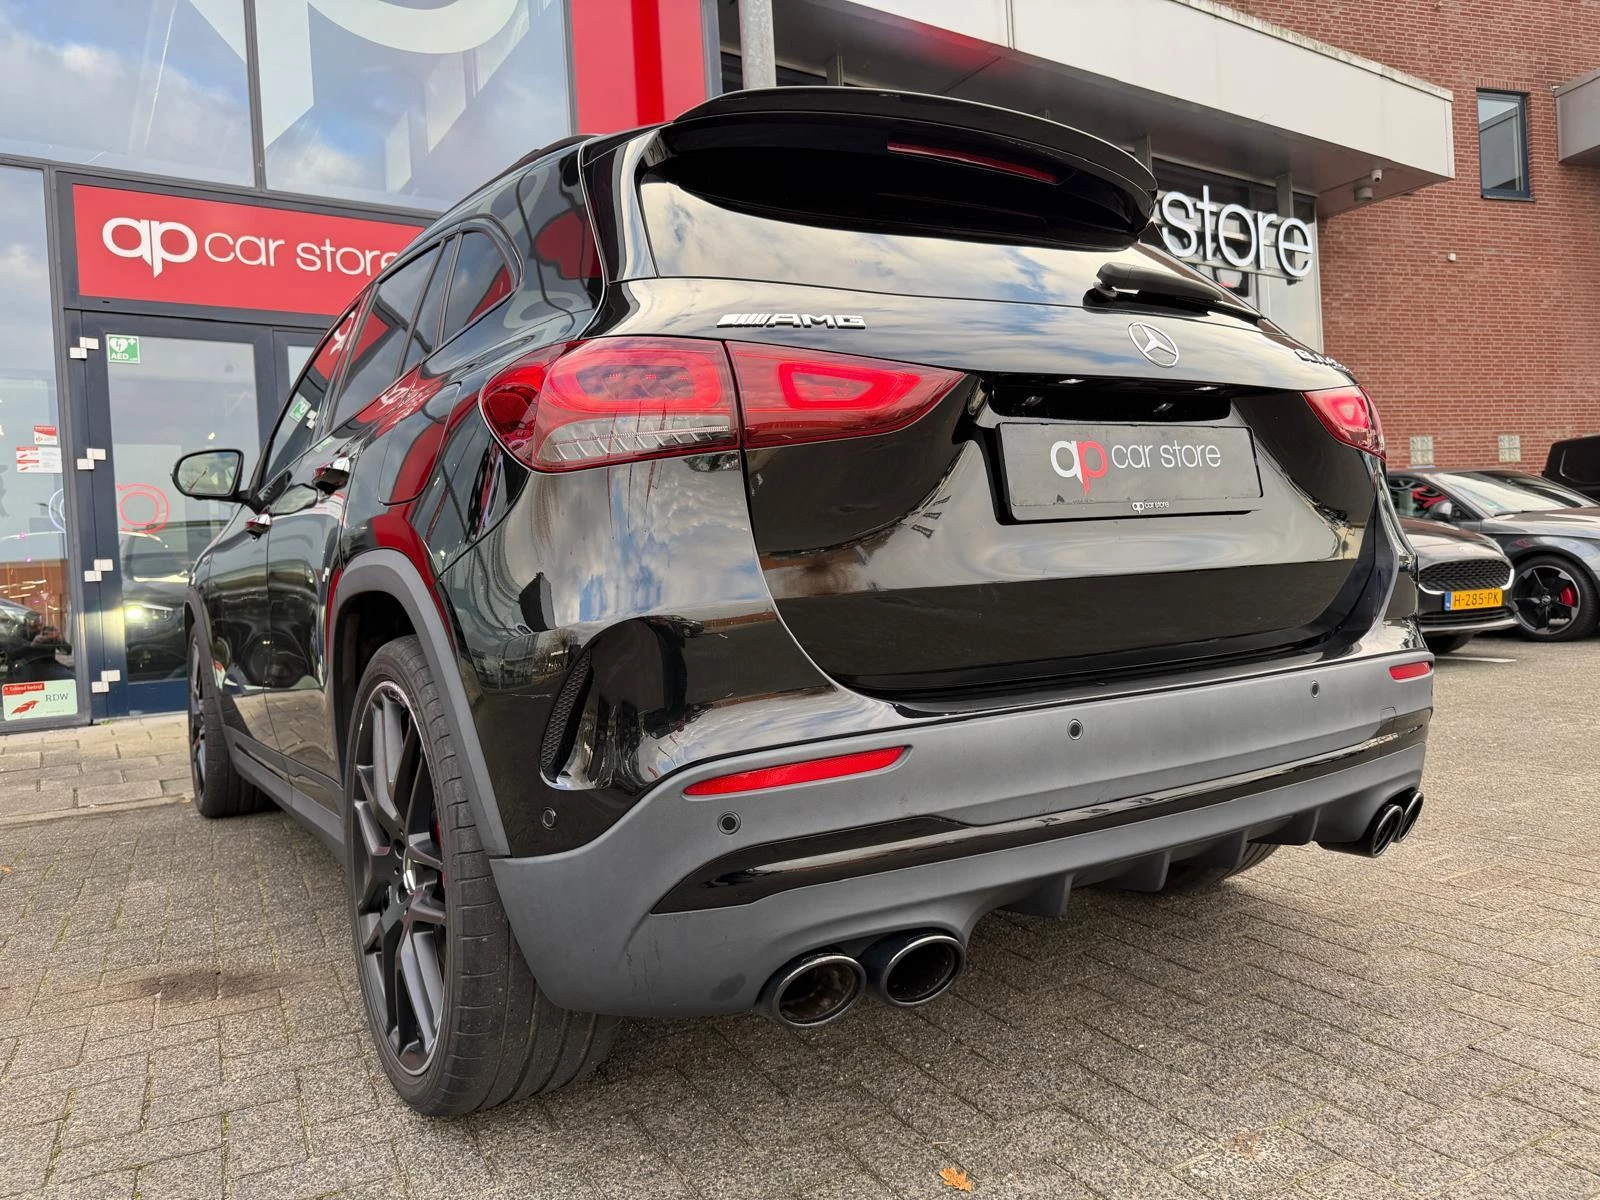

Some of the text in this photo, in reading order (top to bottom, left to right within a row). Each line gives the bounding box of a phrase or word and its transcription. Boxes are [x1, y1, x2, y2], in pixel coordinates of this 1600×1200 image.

[1161, 185, 1314, 277] store
[102, 217, 198, 278] ap
[204, 232, 284, 267] car
[765, 313, 866, 329] AMG
[111, 352, 129, 360] AED
[1050, 440, 1221, 495] ap car store
[1131, 502, 1145, 514] ap
[1454, 592, 1499, 607] H-285-PK
[45, 693, 69, 702] RDW
